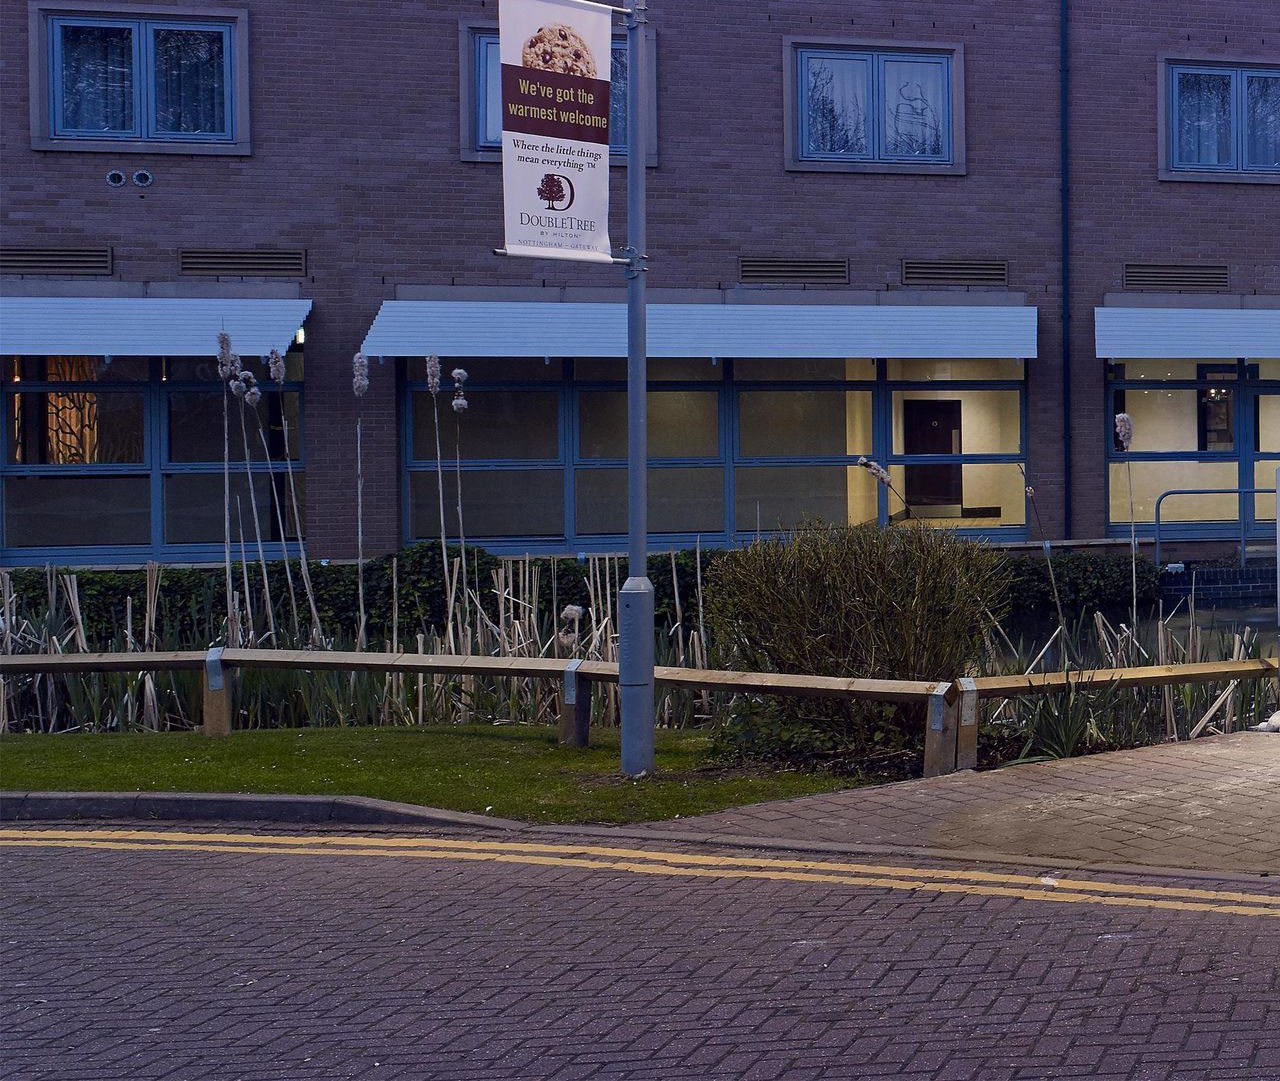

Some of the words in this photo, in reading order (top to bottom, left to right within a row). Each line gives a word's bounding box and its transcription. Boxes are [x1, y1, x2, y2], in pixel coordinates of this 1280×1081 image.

[519, 78, 553, 98] We've
[556, 88, 574, 103] got
[577, 89, 594, 104] the
[508, 103, 557, 121] warmest
[560, 110, 608, 128] welcome
[512, 138, 540, 151] Where
[541, 143, 554, 153] the
[556, 144, 576, 156] little
[577, 148, 602, 162] things
[517, 155, 539, 164] mean
[541, 157, 584, 172] everything
